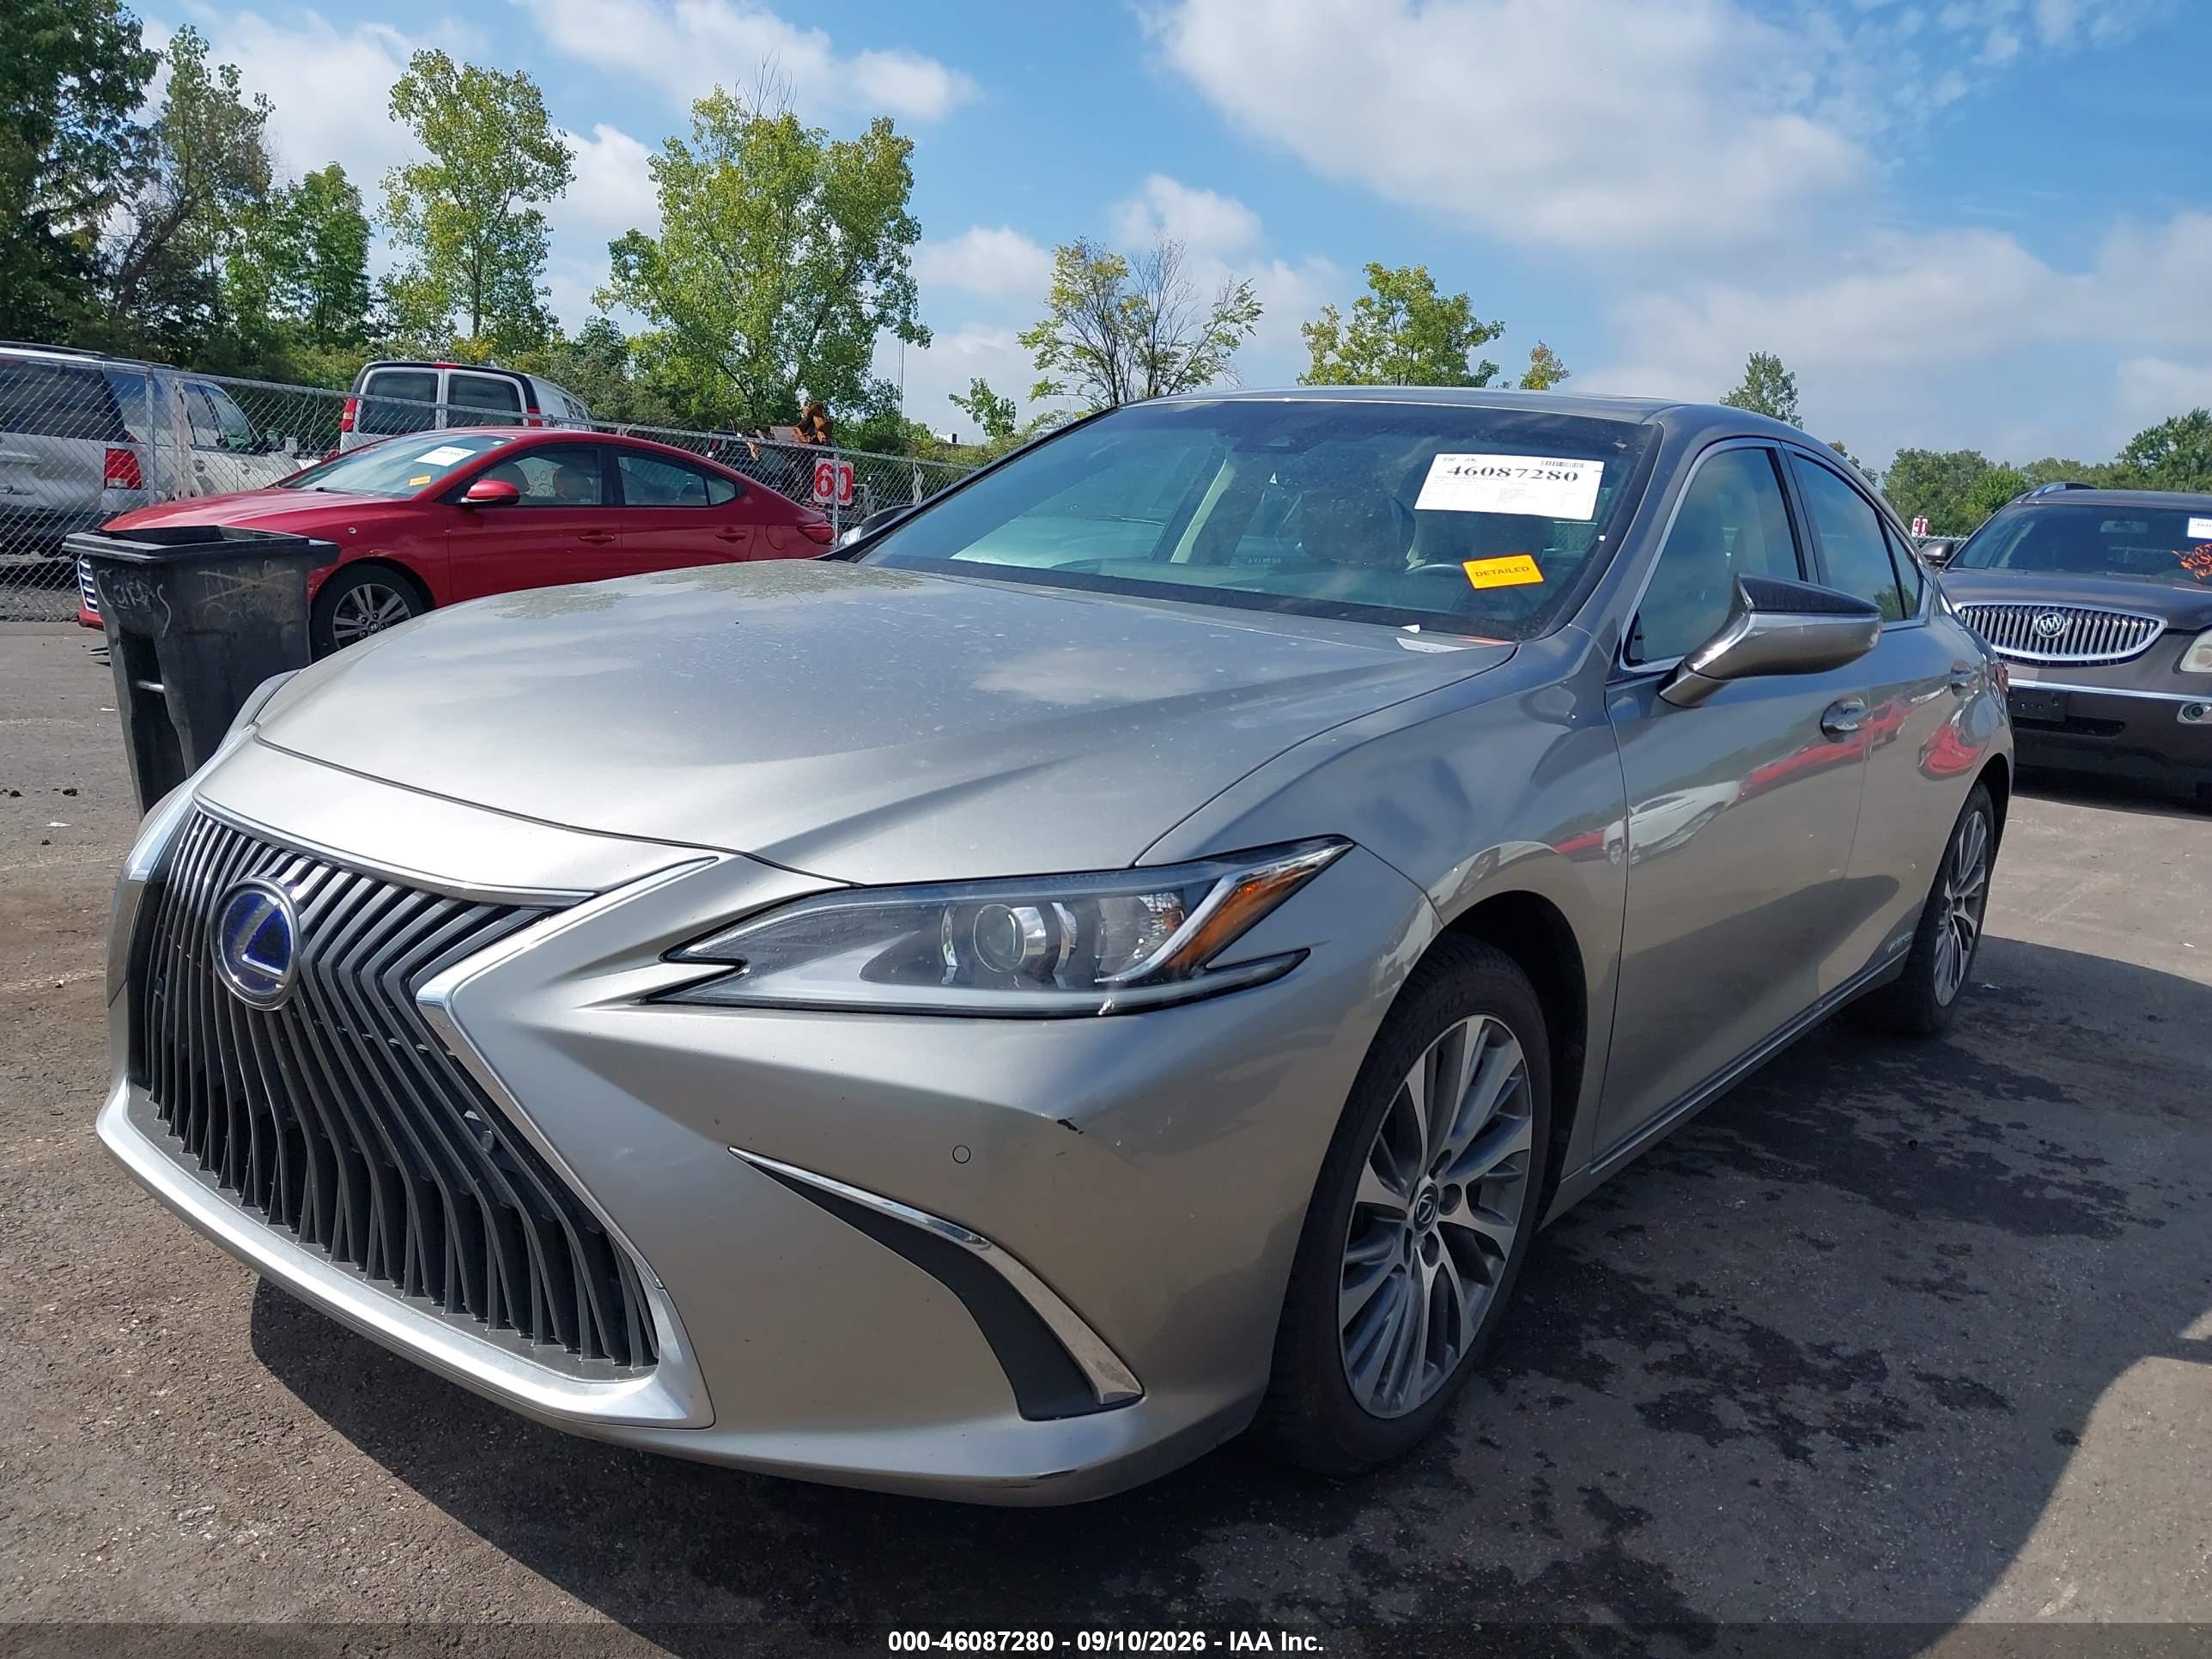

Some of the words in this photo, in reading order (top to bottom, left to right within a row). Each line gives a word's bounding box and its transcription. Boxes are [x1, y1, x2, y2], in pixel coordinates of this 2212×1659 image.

[815, 463, 853, 501] 60
[1447, 465, 1578, 482] 46087280
[1474, 565, 1530, 578] DETAILED
